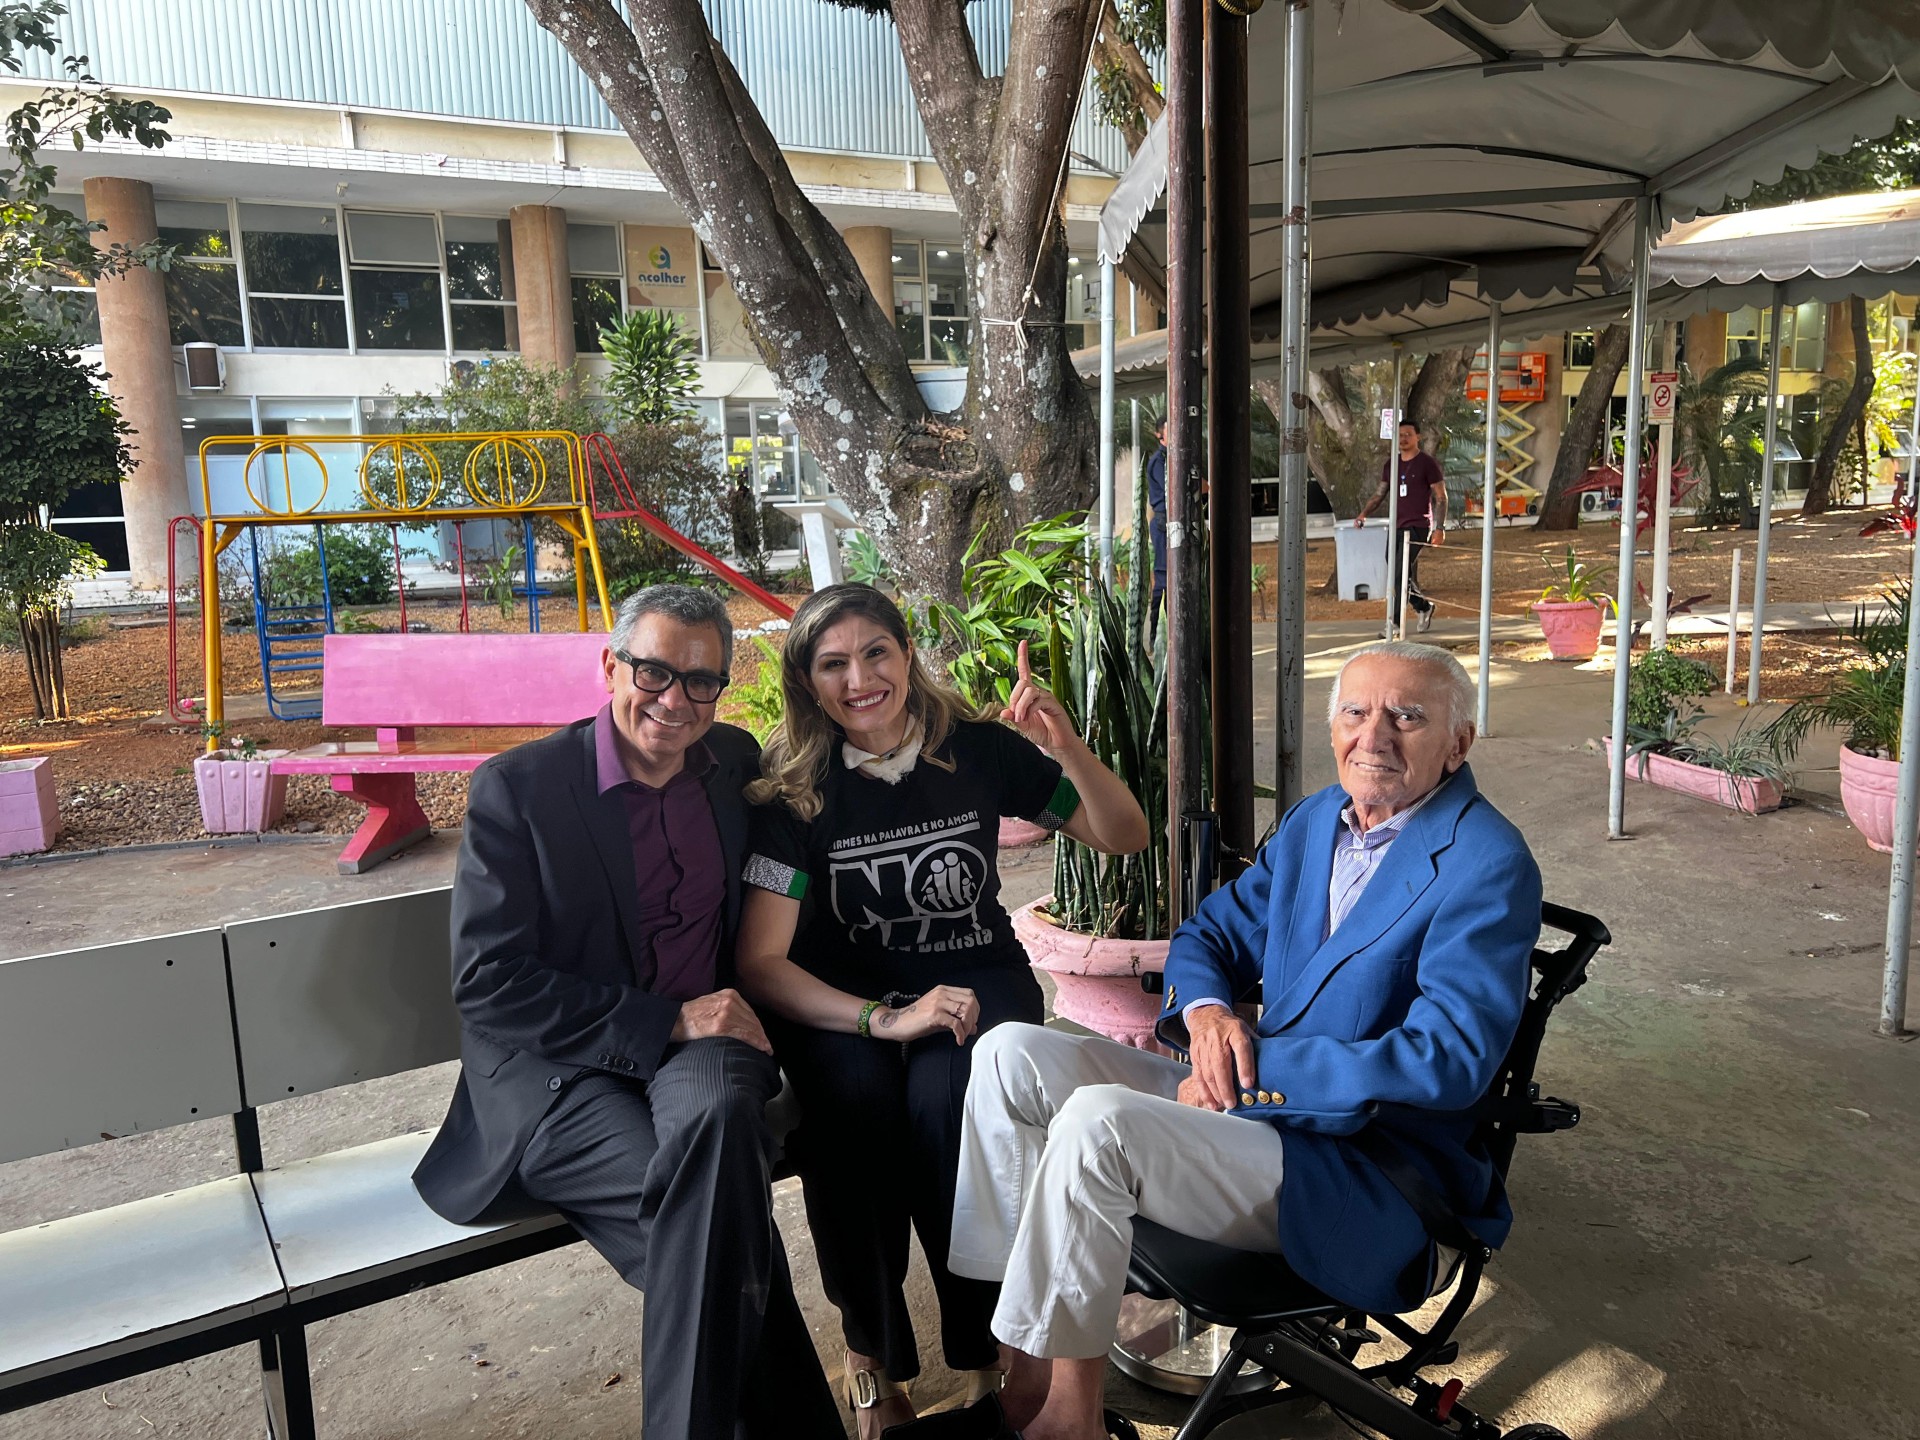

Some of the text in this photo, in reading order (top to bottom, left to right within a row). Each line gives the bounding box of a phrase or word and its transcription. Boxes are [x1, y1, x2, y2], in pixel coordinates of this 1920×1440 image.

[638, 272, 686, 283] acolher
[829, 835, 862, 850] IRMES
[864, 834, 878, 844] NA
[879, 825, 921, 842] PALAVRA
[922, 822, 929, 832] E
[930, 820, 945, 831] NO
